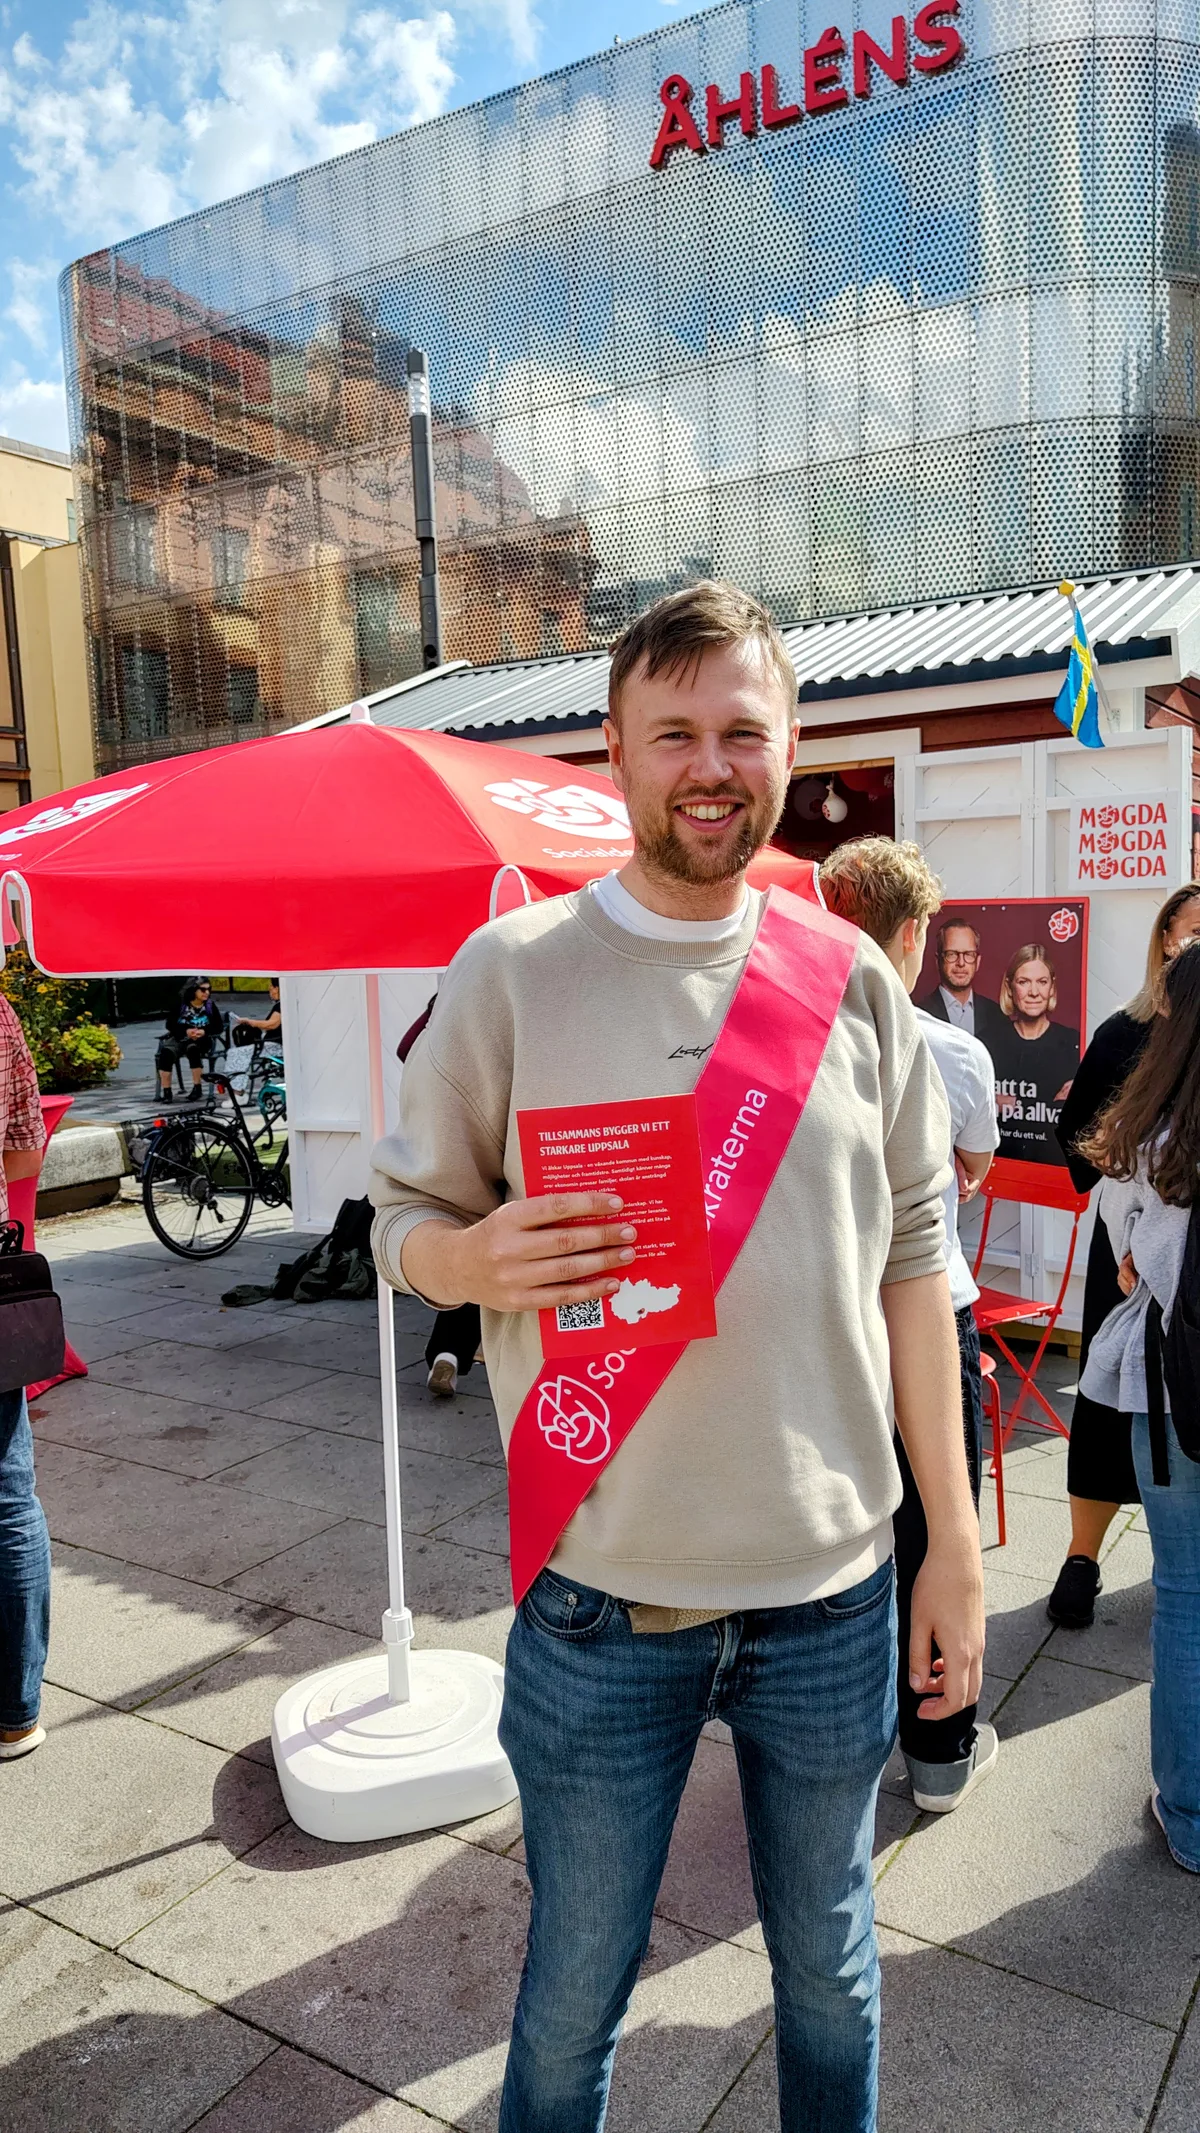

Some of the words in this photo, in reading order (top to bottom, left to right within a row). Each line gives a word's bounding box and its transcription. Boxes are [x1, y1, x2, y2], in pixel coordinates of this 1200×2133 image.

[650, 0, 963, 170] ÅHLÉNS
[1019, 1079, 1037, 1098] ta
[1002, 1100, 1024, 1122] på
[538, 1127, 602, 1142] TILLSAMMANS
[602, 1123, 640, 1137] BYGGER
[640, 1122, 651, 1132] VI
[652, 1120, 671, 1132] ETT
[1013, 1129, 1023, 1139] du
[1023, 1132, 1034, 1140] ett
[1034, 1132, 1048, 1142] val.
[539, 1143, 587, 1157] STARKARE
[588, 1139, 630, 1153] UPPSALA
